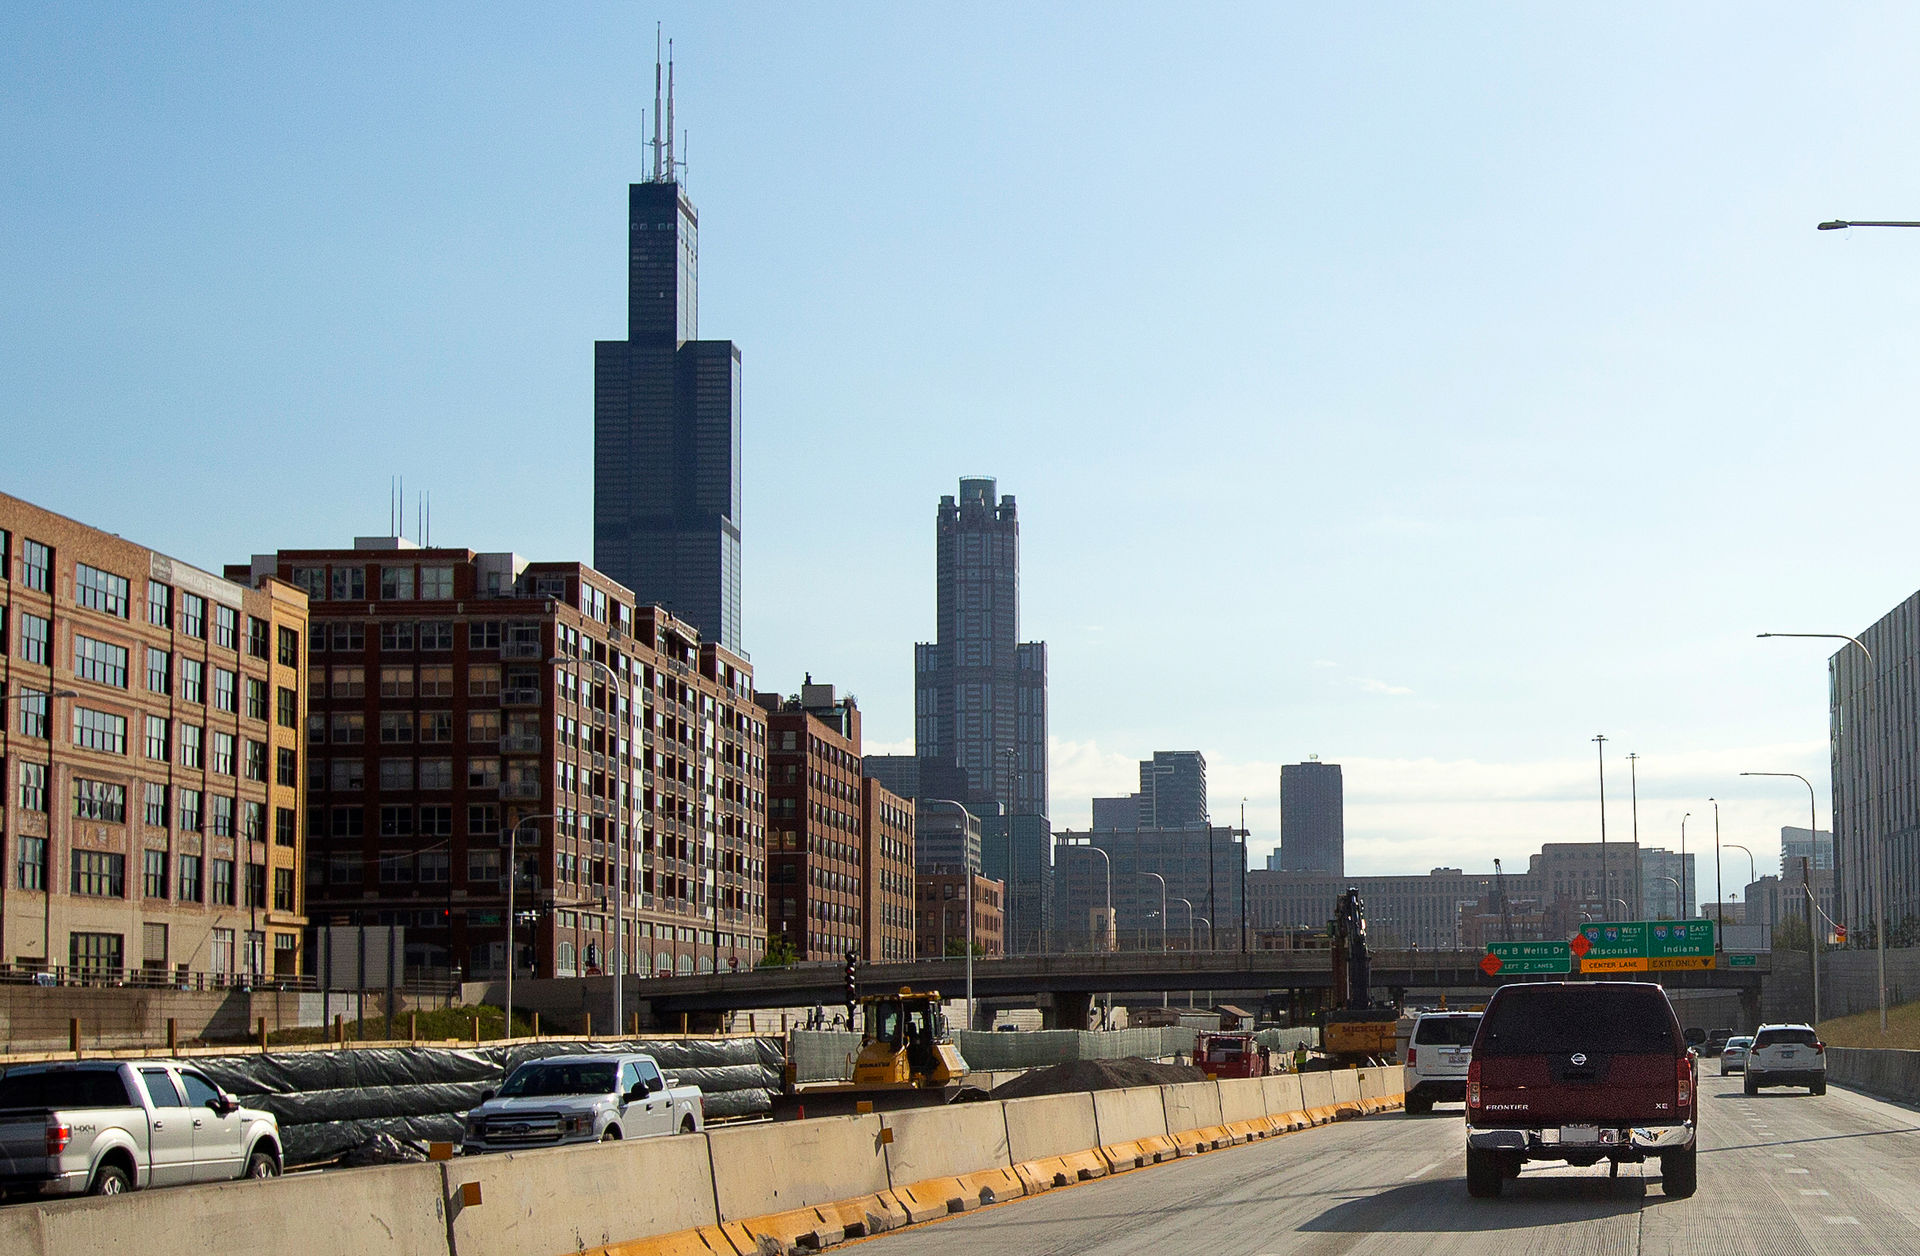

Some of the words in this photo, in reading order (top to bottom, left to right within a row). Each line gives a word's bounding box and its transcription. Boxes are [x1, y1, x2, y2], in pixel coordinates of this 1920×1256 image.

[1656, 930, 1666, 938] 90
[1512, 947, 1518, 955] B
[1523, 946, 1548, 954] Wells
[1553, 946, 1564, 954] Dr
[1590, 947, 1638, 955] Wisconsin
[1663, 945, 1700, 953] Indiana
[1523, 962, 1530, 970] 2
[1652, 960, 1674, 968] EXIT
[1675, 960, 1698, 968] ONLY
